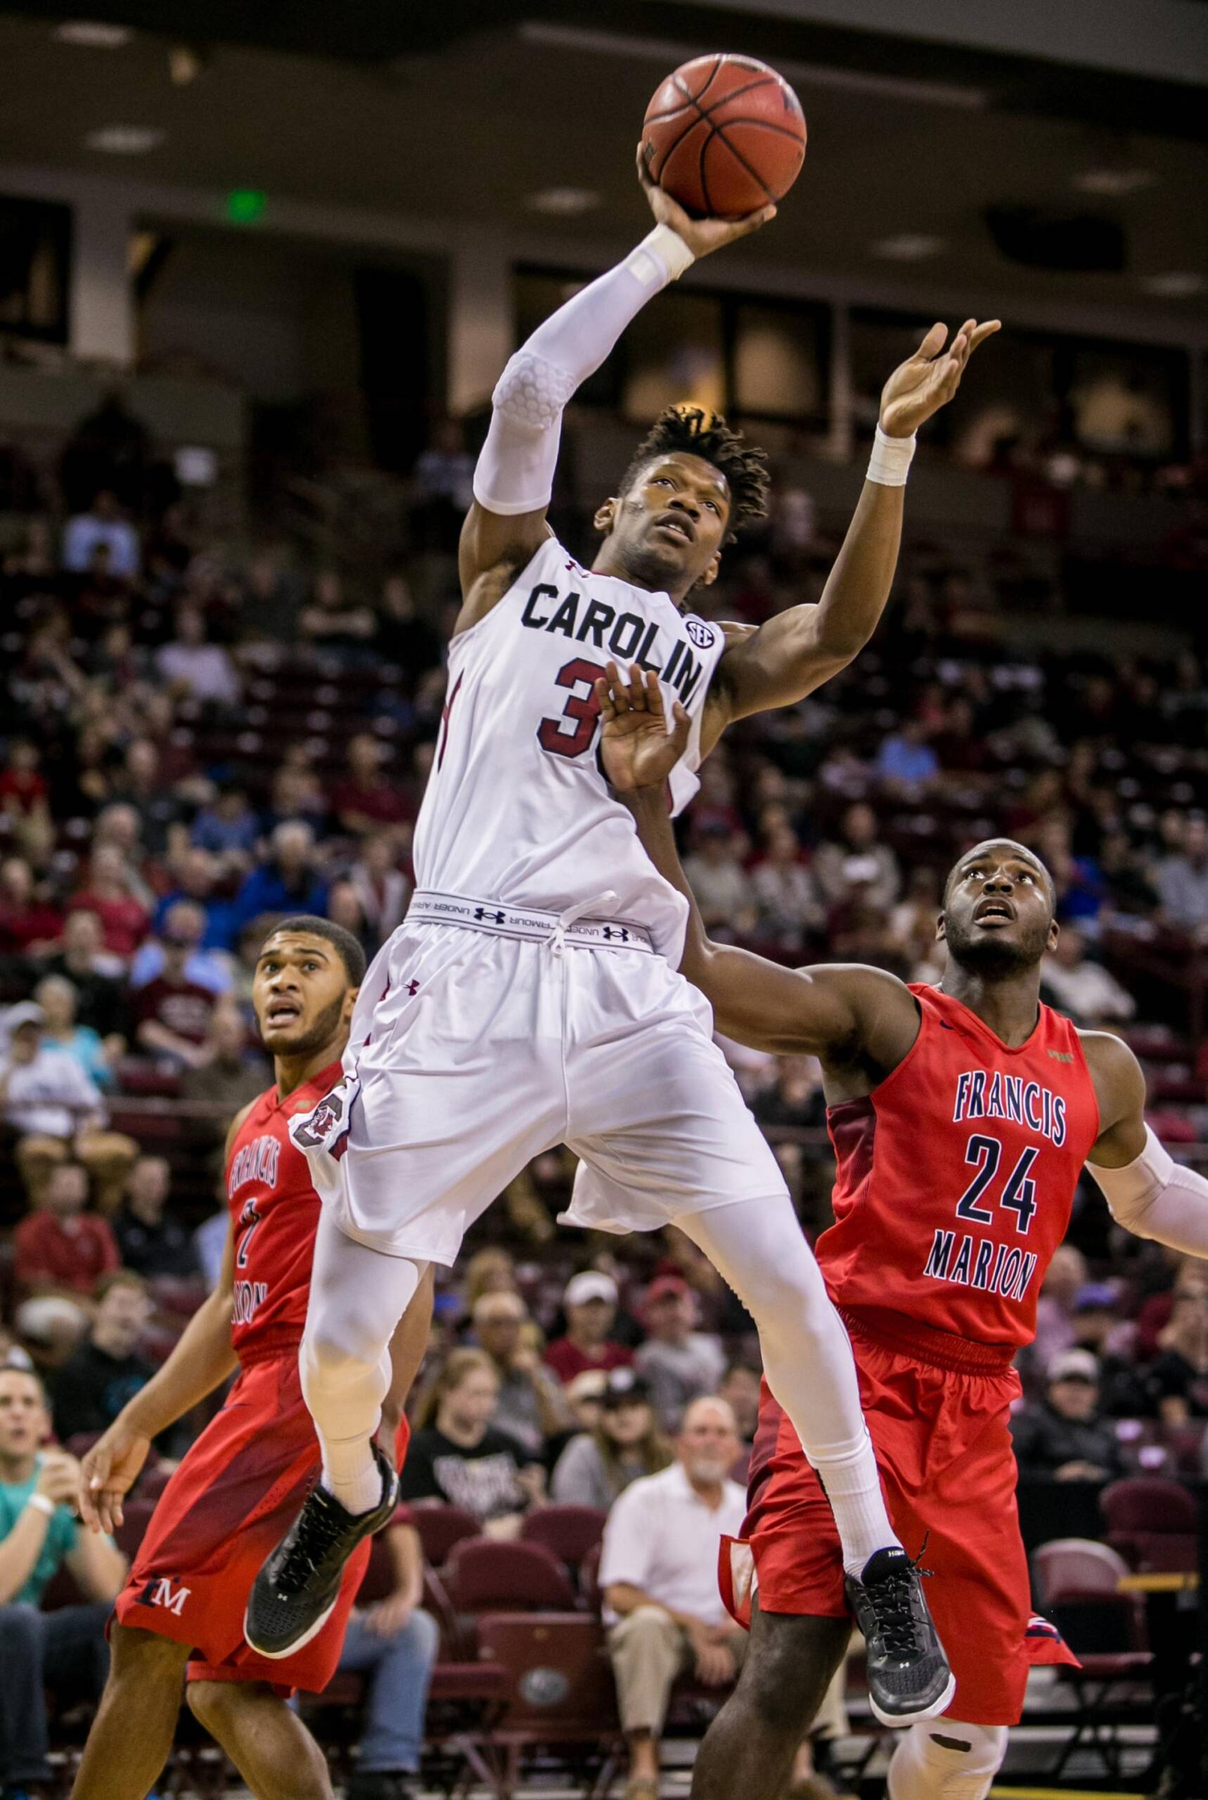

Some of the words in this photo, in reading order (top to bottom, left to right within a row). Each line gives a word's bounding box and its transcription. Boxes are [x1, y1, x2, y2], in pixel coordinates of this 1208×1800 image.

[521, 582, 703, 711] CAROLIN
[687, 621, 715, 649] SEC
[433, 903, 470, 916] UNDER
[953, 1070, 1067, 1148] FRANCIS
[955, 1133, 1040, 1236] 24
[923, 1228, 1038, 1303] MARION
